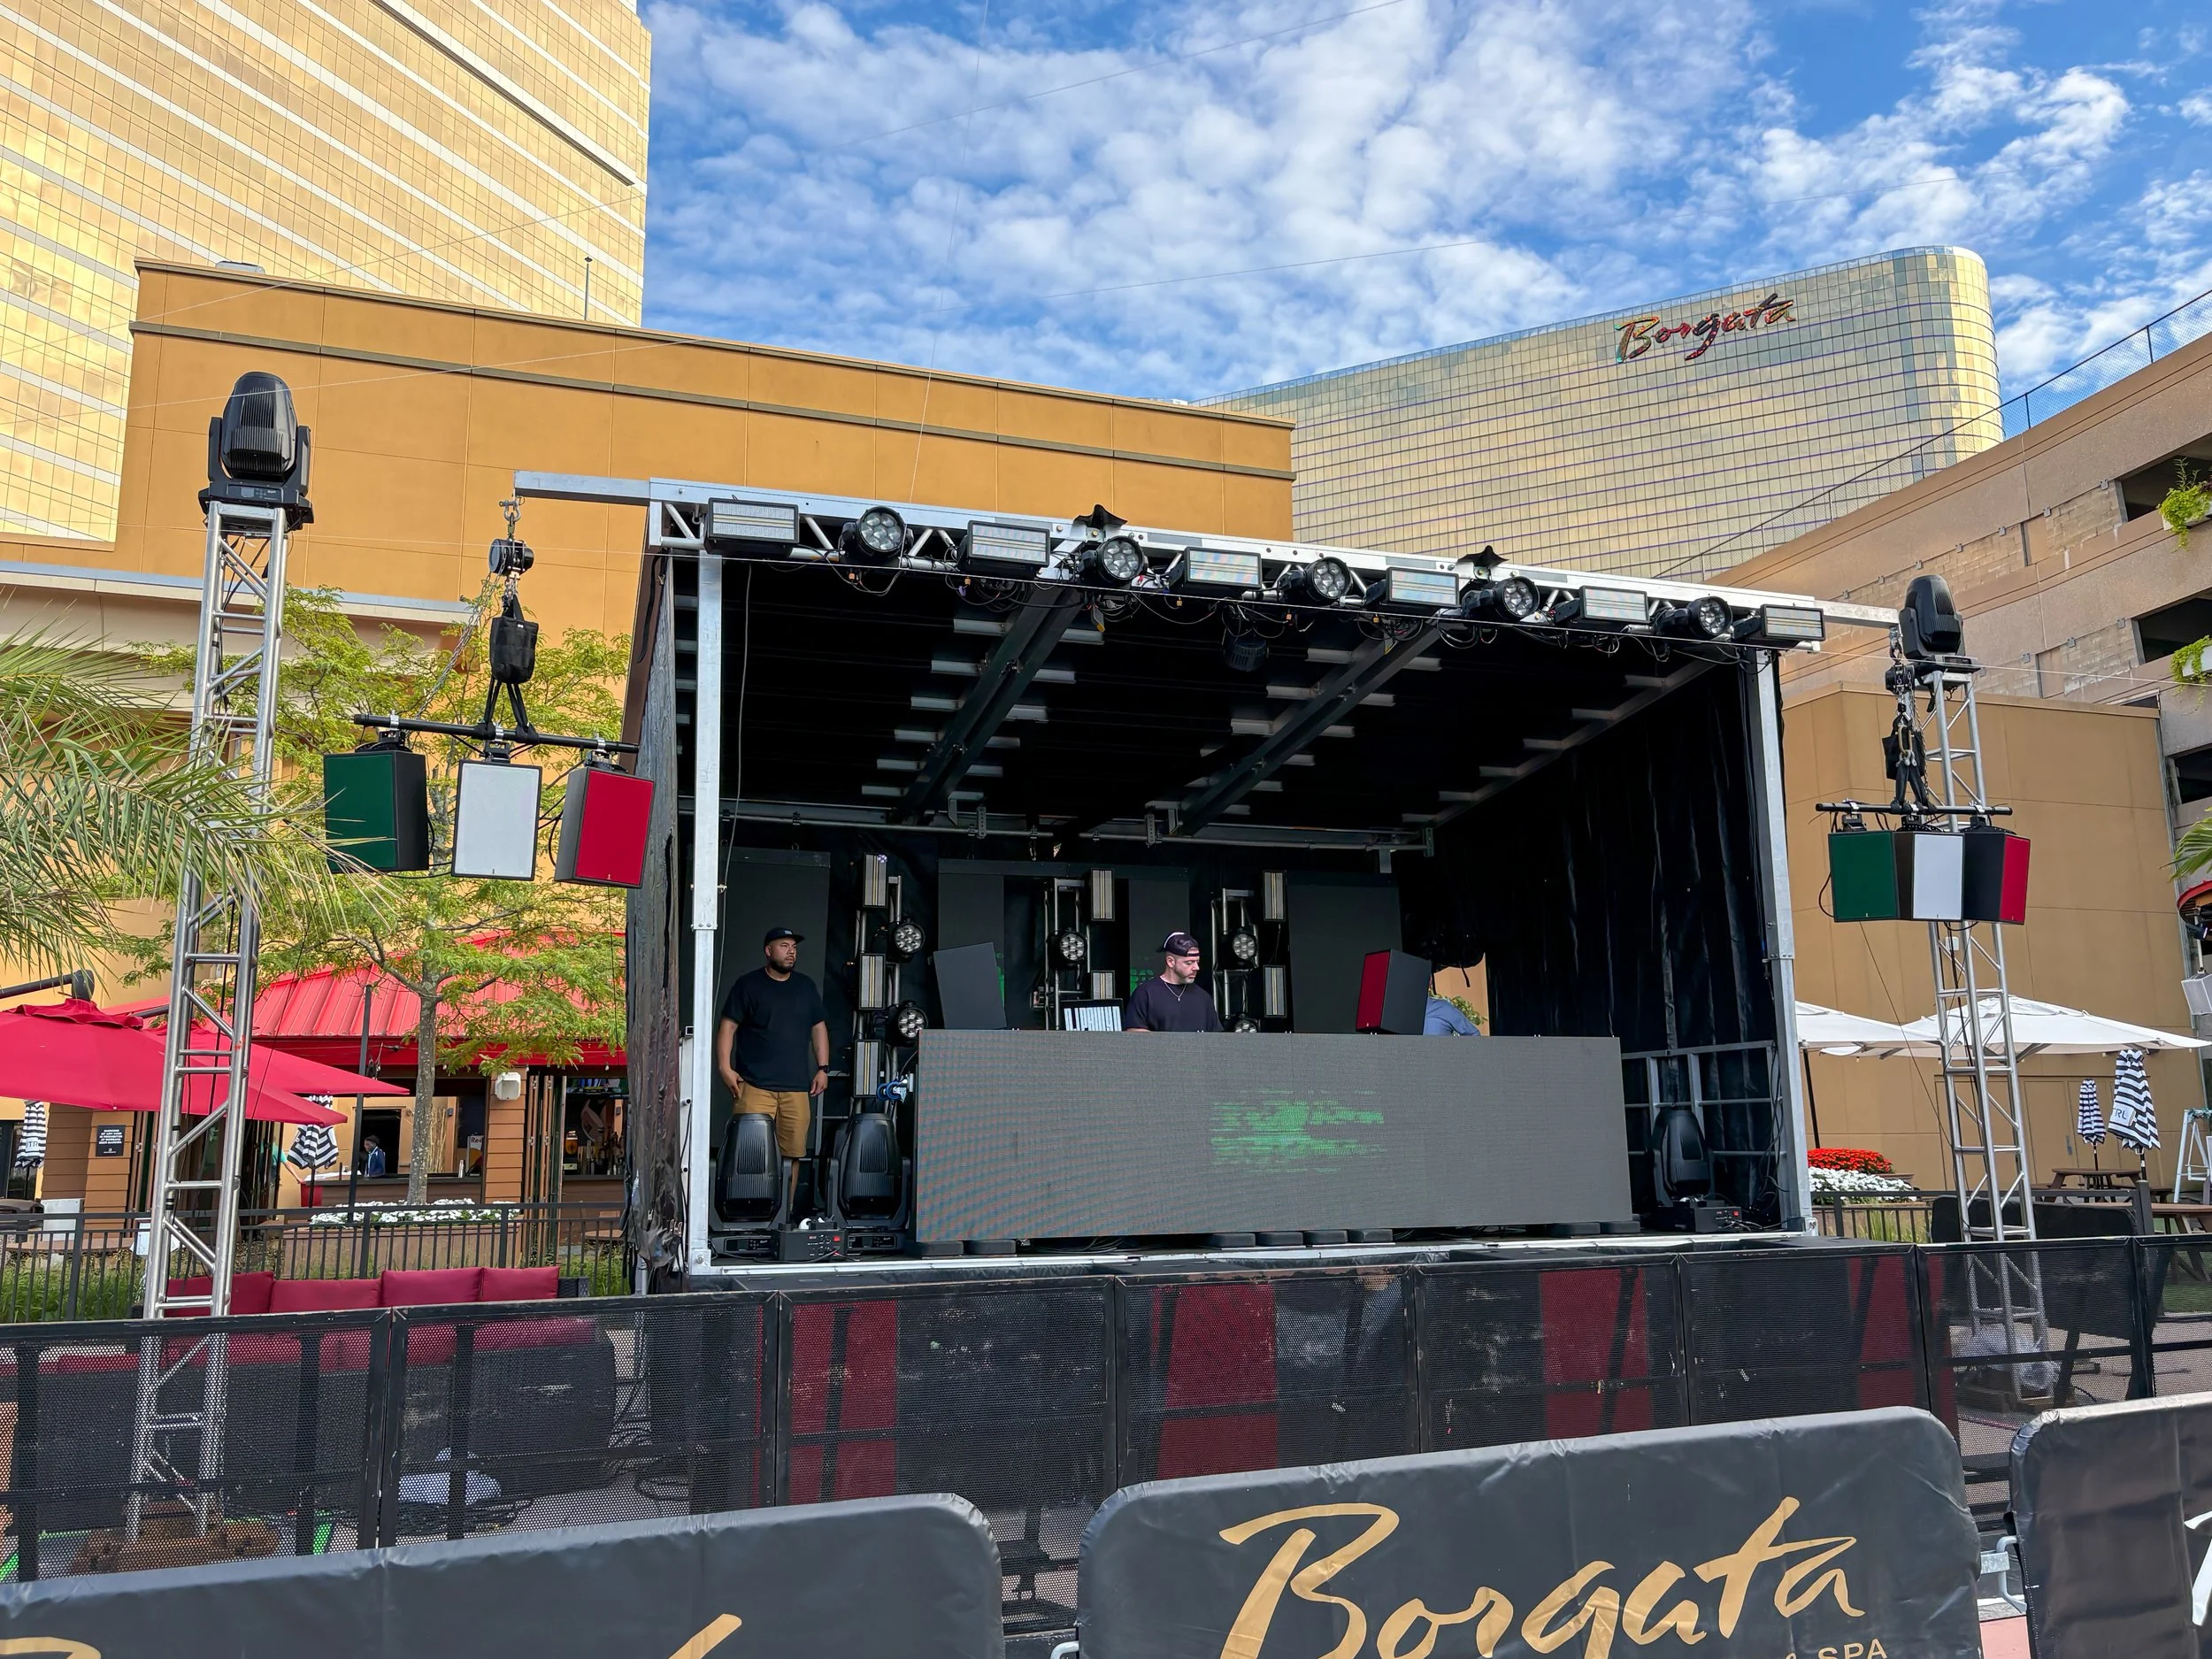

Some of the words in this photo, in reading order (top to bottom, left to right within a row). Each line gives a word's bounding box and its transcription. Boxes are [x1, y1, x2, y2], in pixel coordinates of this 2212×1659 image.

[1614, 293, 1796, 363] Borgata
[1218, 1496, 1865, 1659] Borgata
[1817, 1638, 1888, 1659] SPA
